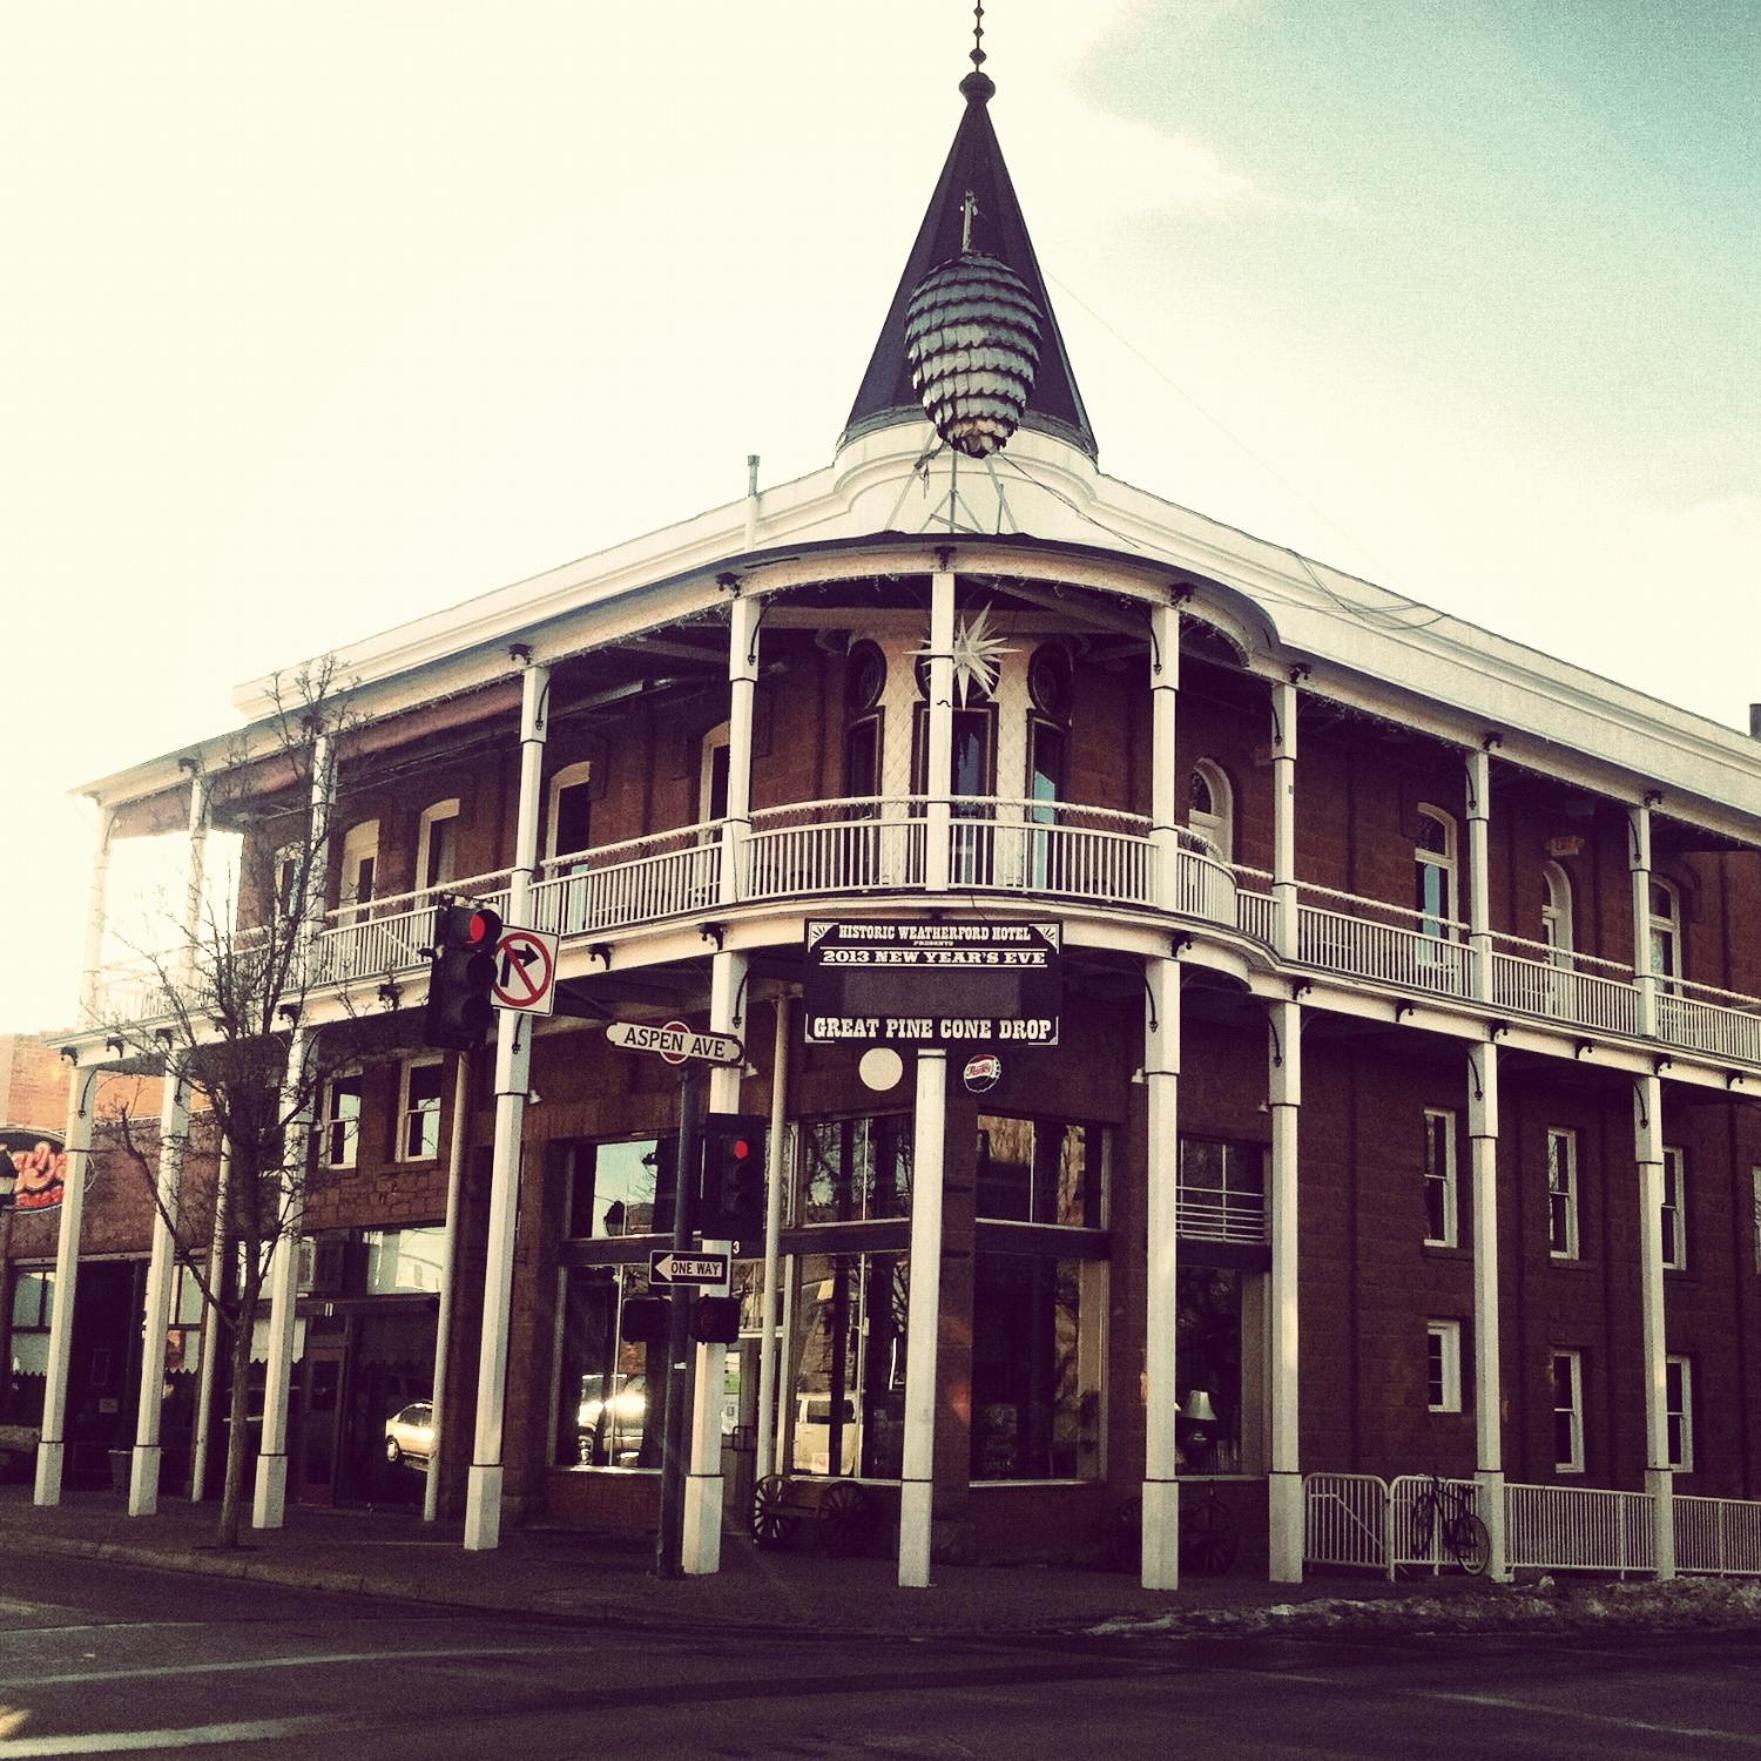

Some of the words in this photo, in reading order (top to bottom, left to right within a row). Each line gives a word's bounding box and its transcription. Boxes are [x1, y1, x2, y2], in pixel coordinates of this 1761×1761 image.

[839, 924, 896, 940] HISTORIC
[900, 925, 988, 940] WEATHERFORD
[992, 926, 1031, 941] HOTEL
[823, 950, 871, 964] 2013
[875, 950, 920, 964] NEW
[923, 950, 999, 964] YEAR'S
[1004, 952, 1046, 964] EVE
[814, 1017, 878, 1038] GREAT
[886, 1018, 933, 1039] PINE
[940, 1019, 992, 1040] CONE
[999, 1019, 1052, 1040] DROP
[624, 1027, 684, 1051] ASPEN
[690, 1037, 726, 1058] AVE
[733, 1240, 740, 1254] 3
[671, 1262, 692, 1274] ONE
[696, 1263, 720, 1275] WAY
